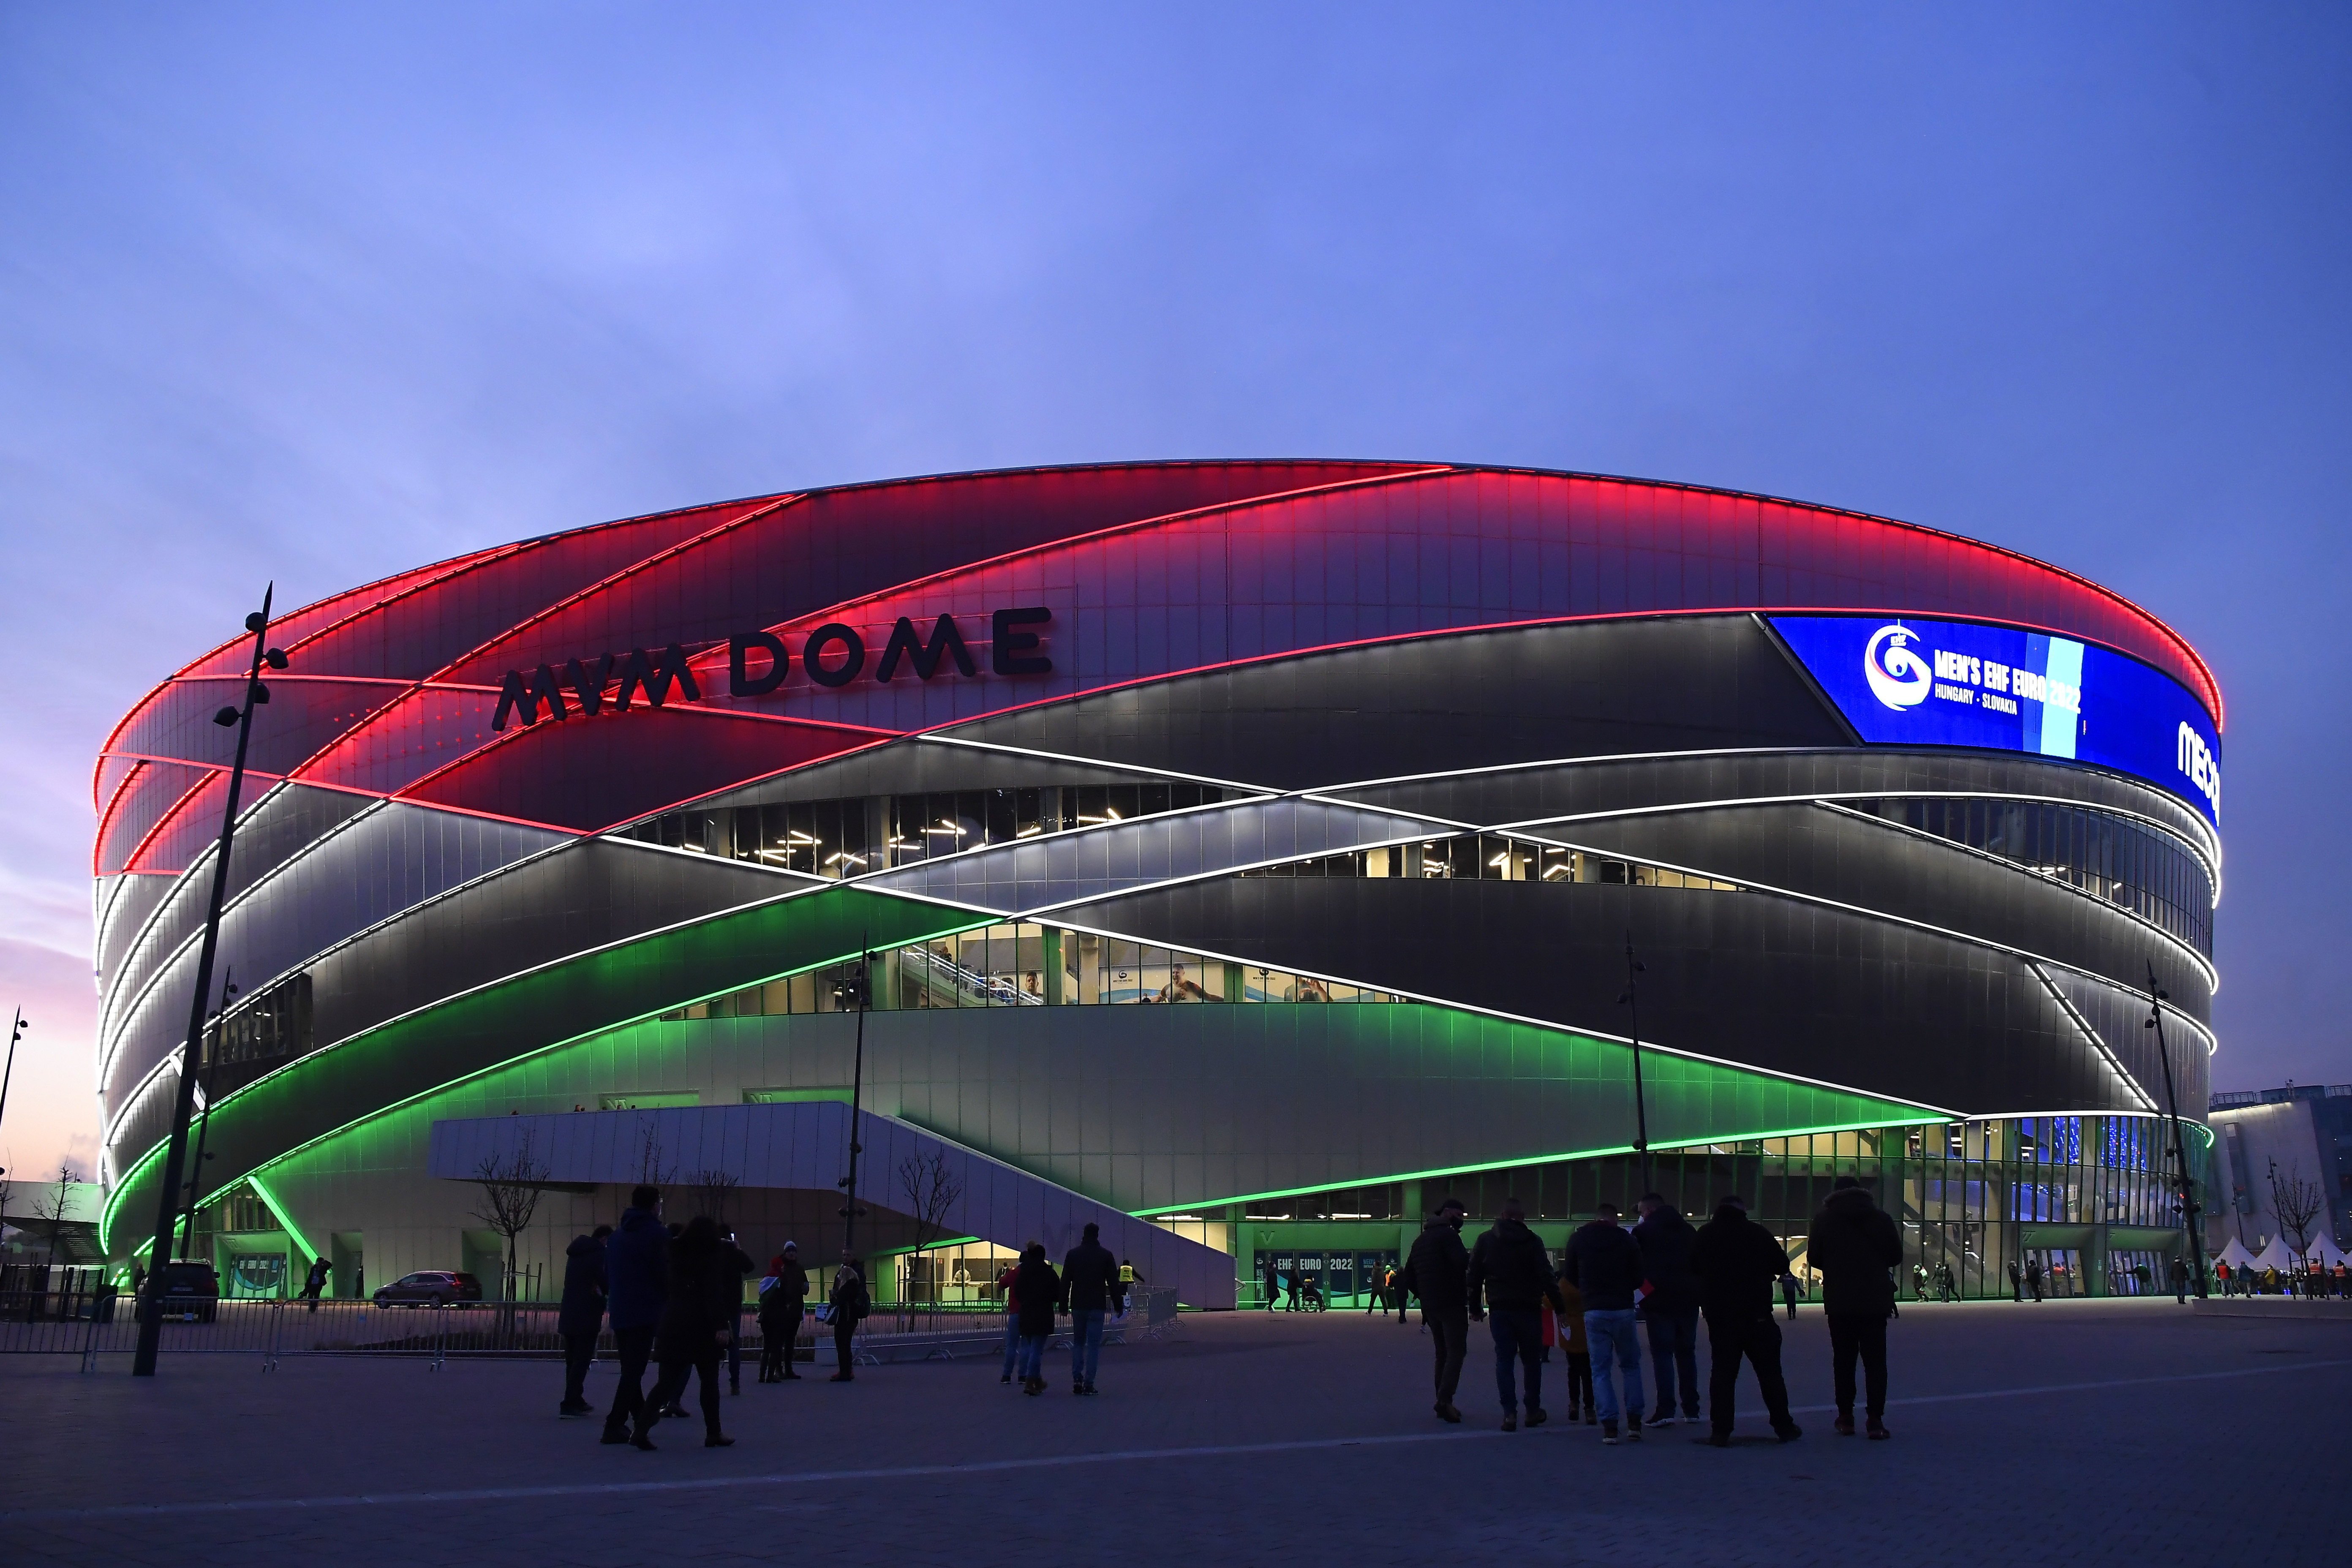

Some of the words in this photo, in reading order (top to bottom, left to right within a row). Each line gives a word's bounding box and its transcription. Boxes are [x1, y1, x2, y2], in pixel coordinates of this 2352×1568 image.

[492, 643, 701, 731] MVM
[730, 607, 1052, 697] DOME
[1934, 649, 1981, 685] MEN'S
[1984, 660, 2009, 692] EHF
[2013, 668, 2046, 702] EURO
[2050, 679, 2081, 714] 2022
[1935, 683, 1974, 705] HUNGARY
[1982, 693, 2017, 715] SLOVAKIA
[1278, 1258, 1293, 1270] EHF
[1300, 1258, 1321, 1270] EURO
[1330, 1258, 1353, 1270] 2022
